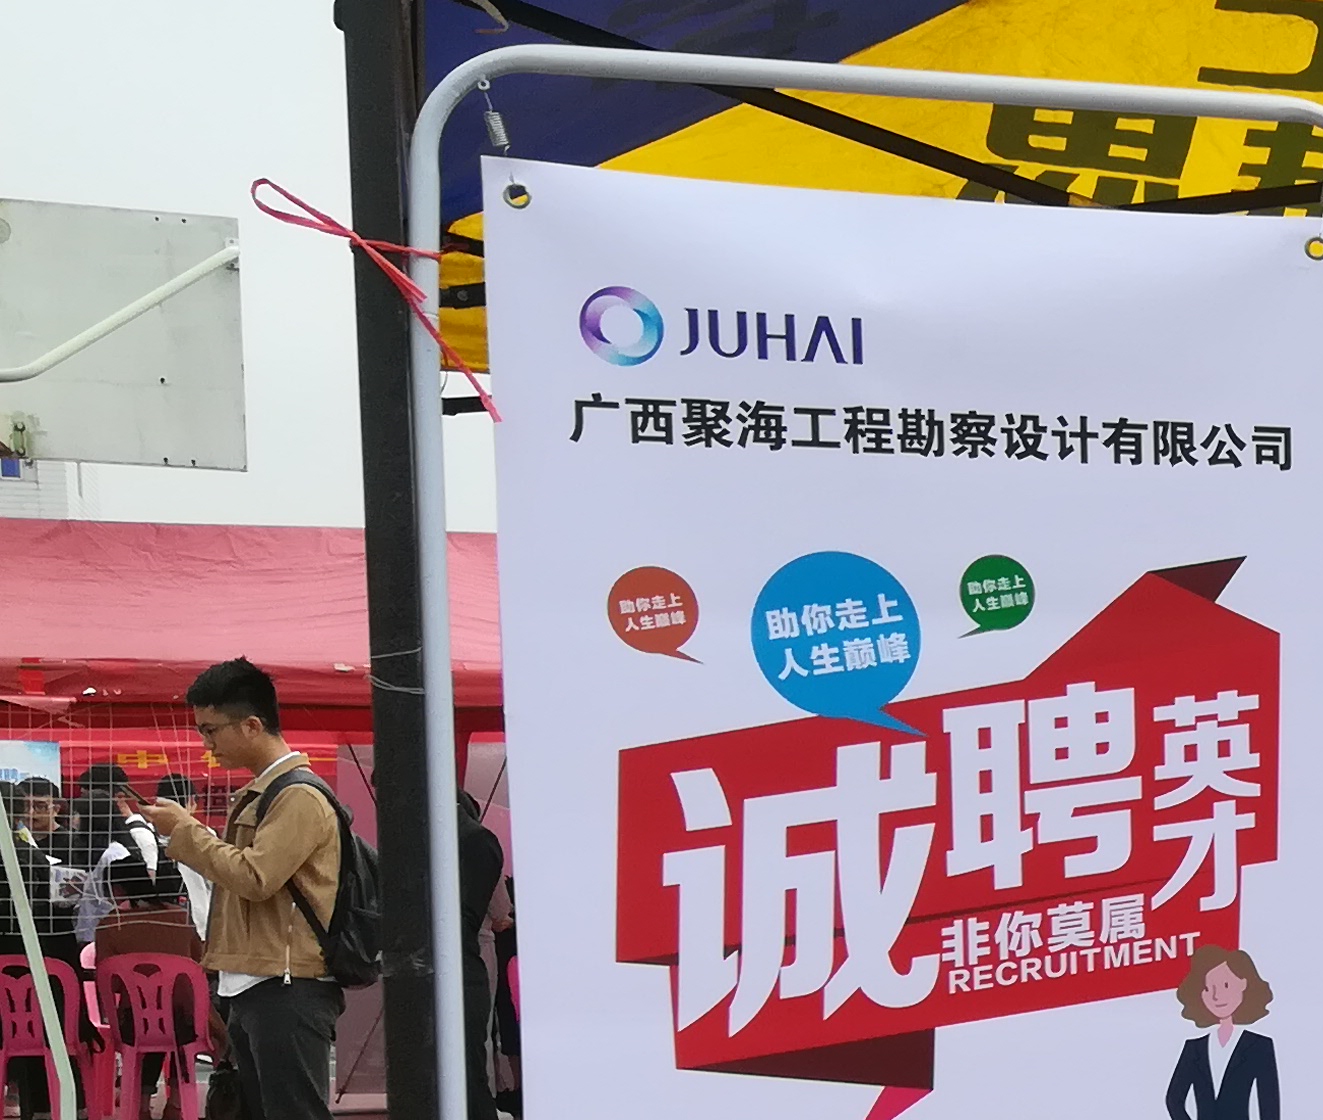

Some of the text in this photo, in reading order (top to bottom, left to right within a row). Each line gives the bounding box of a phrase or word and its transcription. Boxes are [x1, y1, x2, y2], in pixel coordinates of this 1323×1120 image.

[680, 308, 864, 366] JUHAI
[570, 393, 1294, 472] 广西聚海工程勘察设计有限公司
[619, 593, 684, 615] 助你走上
[967, 574, 1027, 596] 助你走上
[765, 593, 904, 641] 助你走上
[778, 632, 911, 680] 人生巅峰
[941, 892, 1146, 968] 非你莫属
[947, 931, 1202, 995] RECRUITMENT
